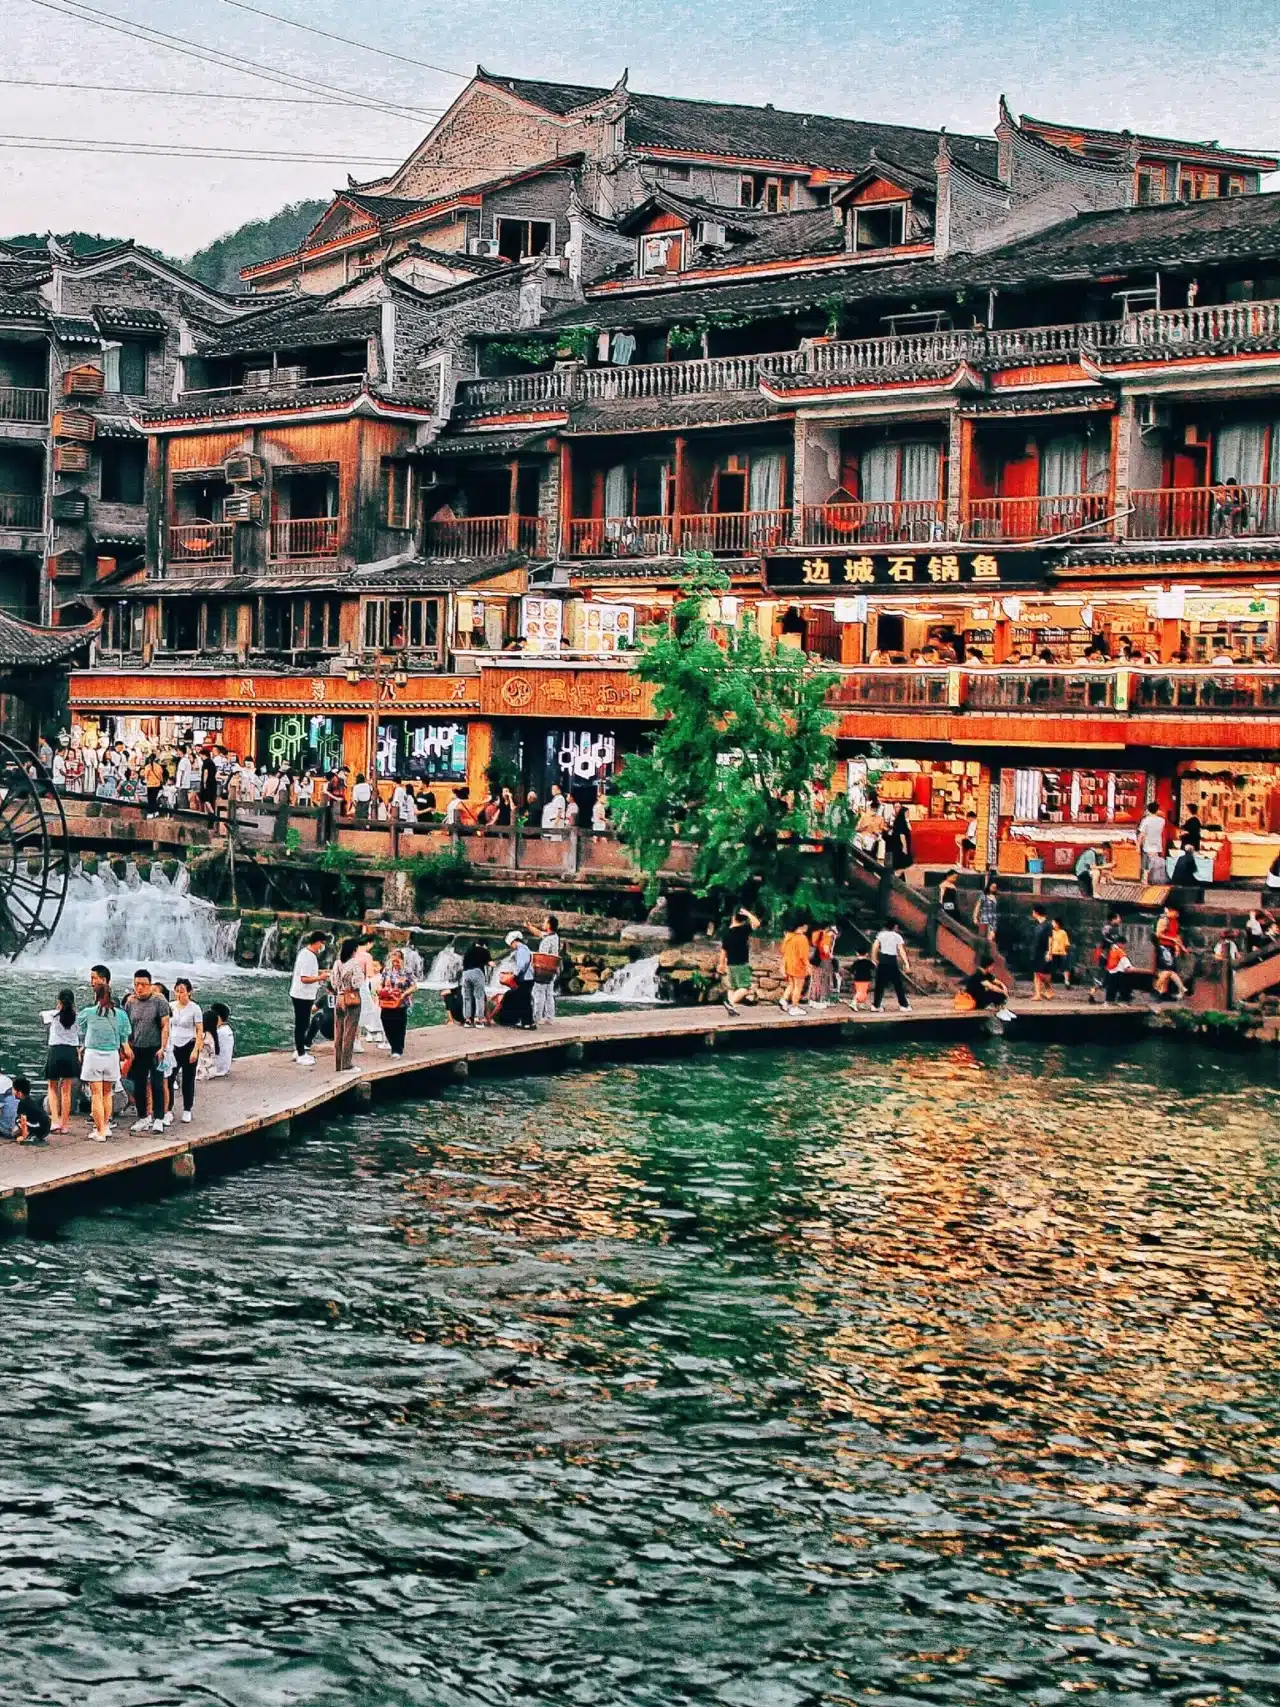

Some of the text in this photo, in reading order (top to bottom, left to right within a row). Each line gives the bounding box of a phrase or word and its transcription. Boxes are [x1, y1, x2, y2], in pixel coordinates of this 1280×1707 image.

[802, 554, 1001, 583] 边城石锅鱼
